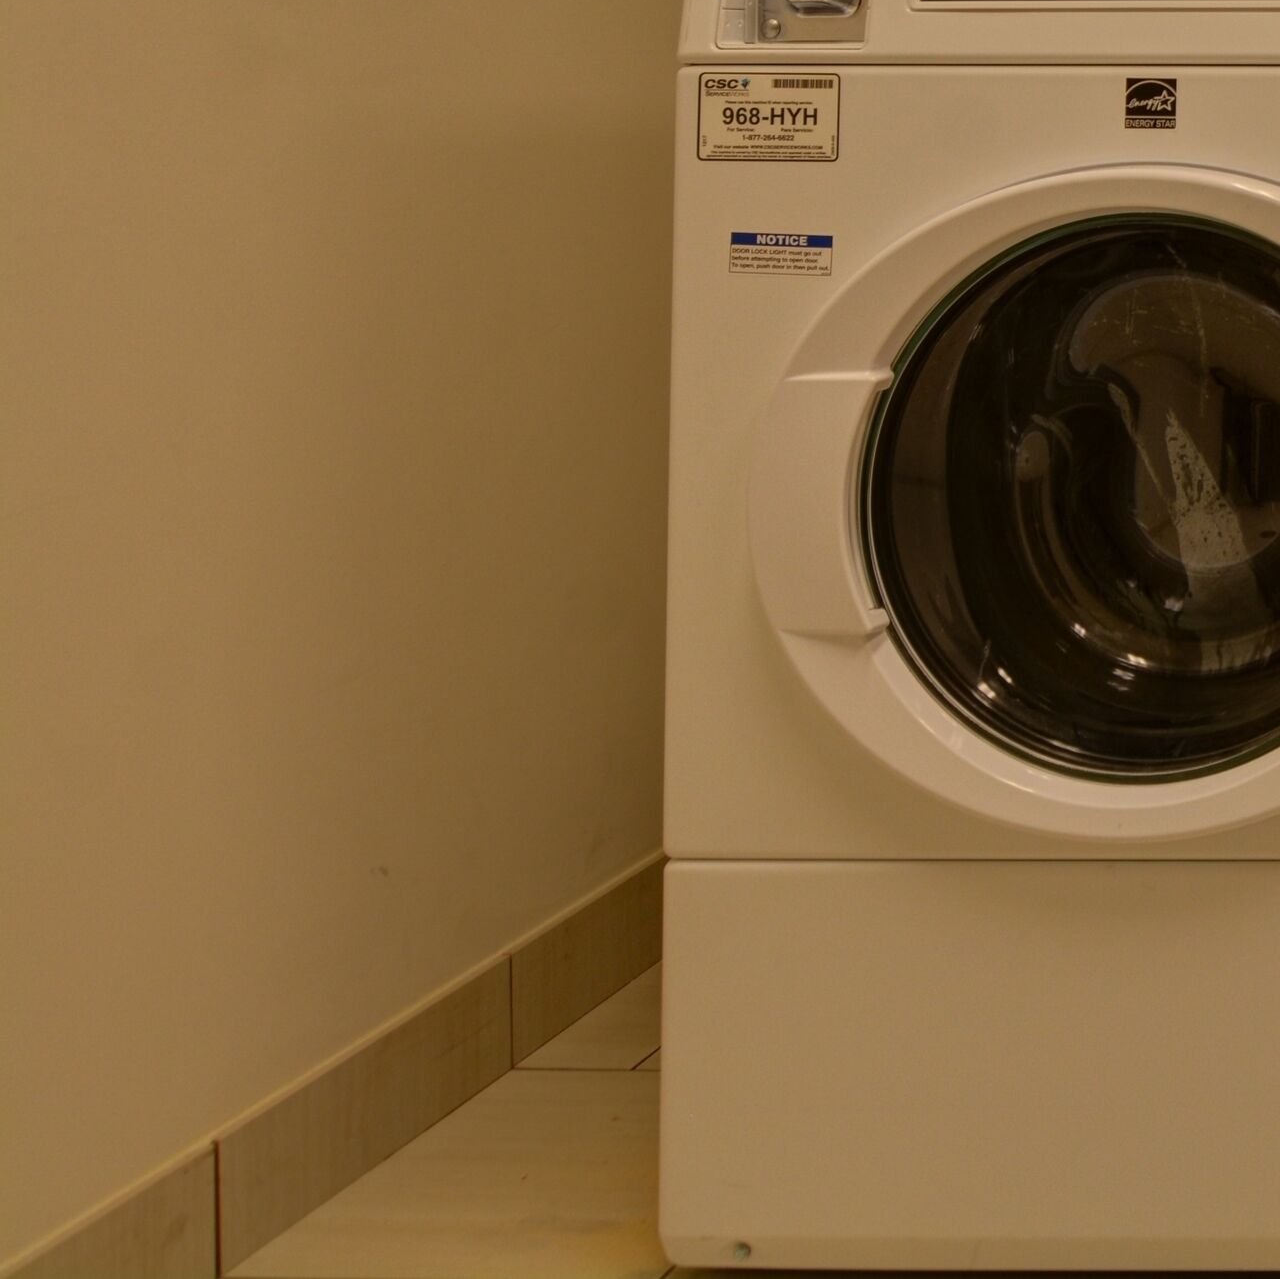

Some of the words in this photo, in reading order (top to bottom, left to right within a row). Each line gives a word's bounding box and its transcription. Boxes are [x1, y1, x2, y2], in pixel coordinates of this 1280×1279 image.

[704, 78, 739, 89] CSC
[722, 107, 818, 125] 968-HYH
[1126, 120, 1154, 128] ENERGY
[1156, 120, 1175, 128] STAR
[756, 234, 808, 246] NOTICE
